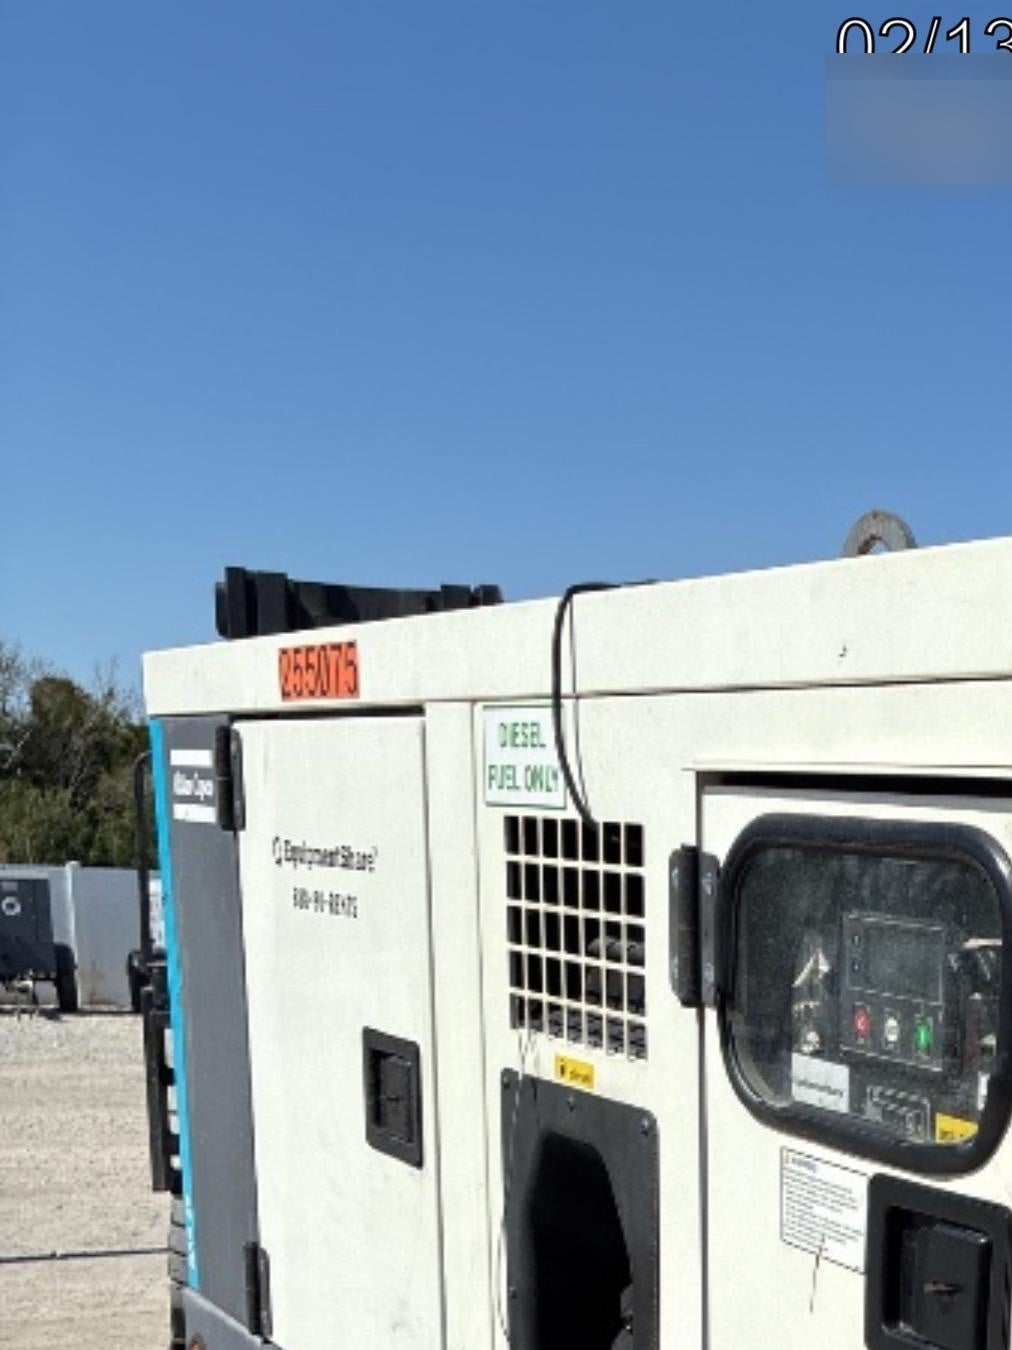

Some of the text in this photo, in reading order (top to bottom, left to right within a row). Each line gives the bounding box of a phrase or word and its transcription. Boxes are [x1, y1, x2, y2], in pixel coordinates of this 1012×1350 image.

[280, 642, 358, 697] 255075
[499, 721, 547, 748] DIESEL
[487, 764, 559, 793] FUEL ONLY
